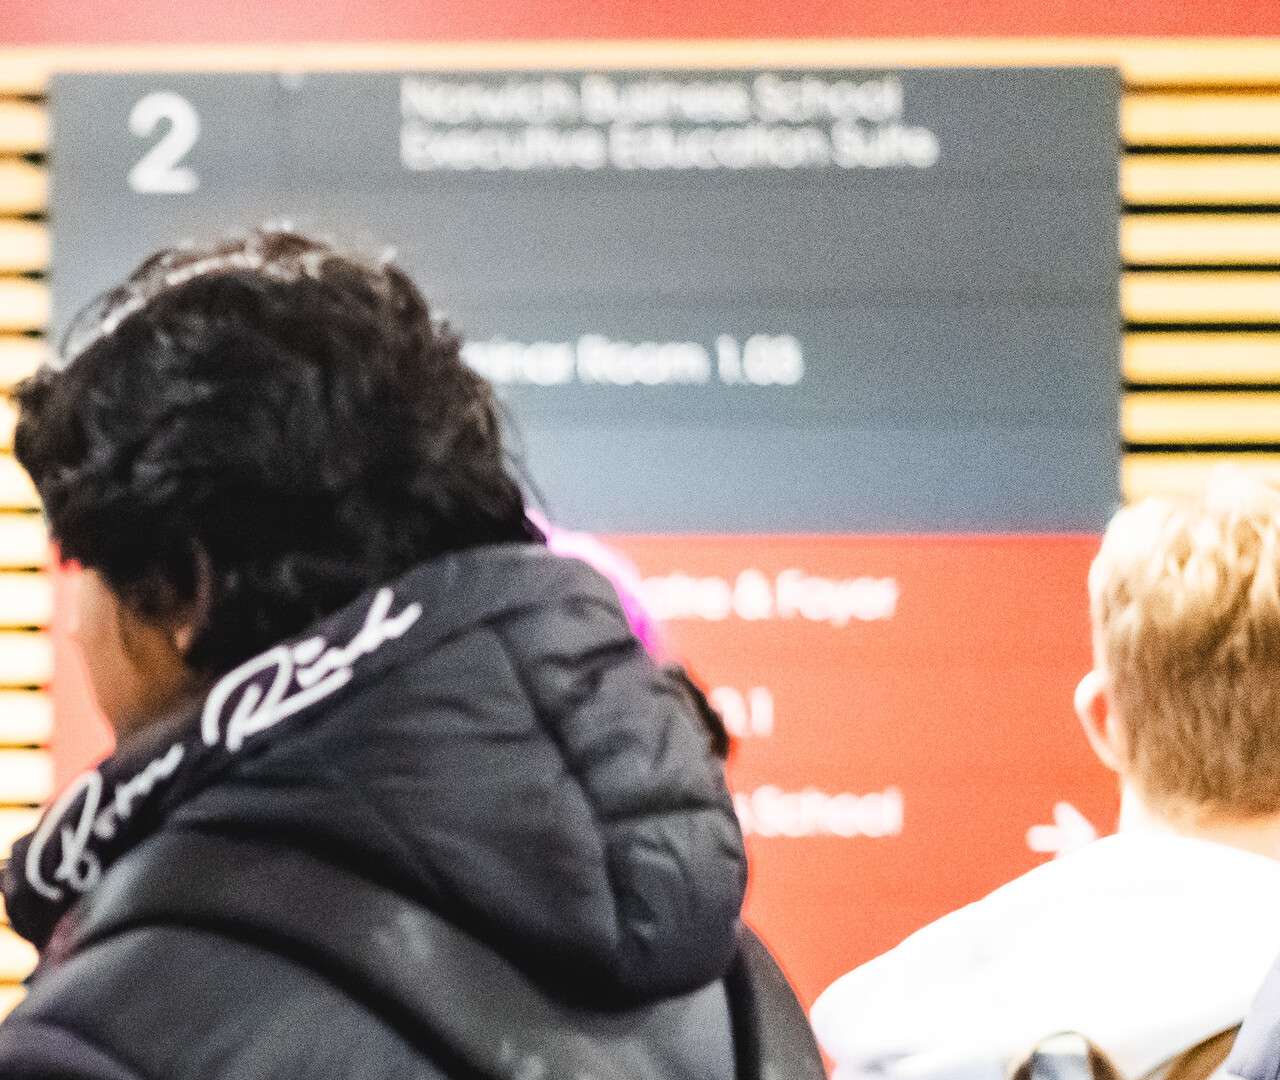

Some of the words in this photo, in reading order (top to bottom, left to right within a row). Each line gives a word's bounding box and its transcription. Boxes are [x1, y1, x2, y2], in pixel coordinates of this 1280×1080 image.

[581, 74, 750, 122] Business
[753, 74, 903, 122] School
[128, 91, 200, 192] 2
[400, 123, 607, 170] Executive
[609, 123, 831, 170] Education
[577, 334, 710, 385] Room
[734, 568, 771, 621] &
[775, 568, 898, 628] Foyer
[752, 784, 904, 838] School
